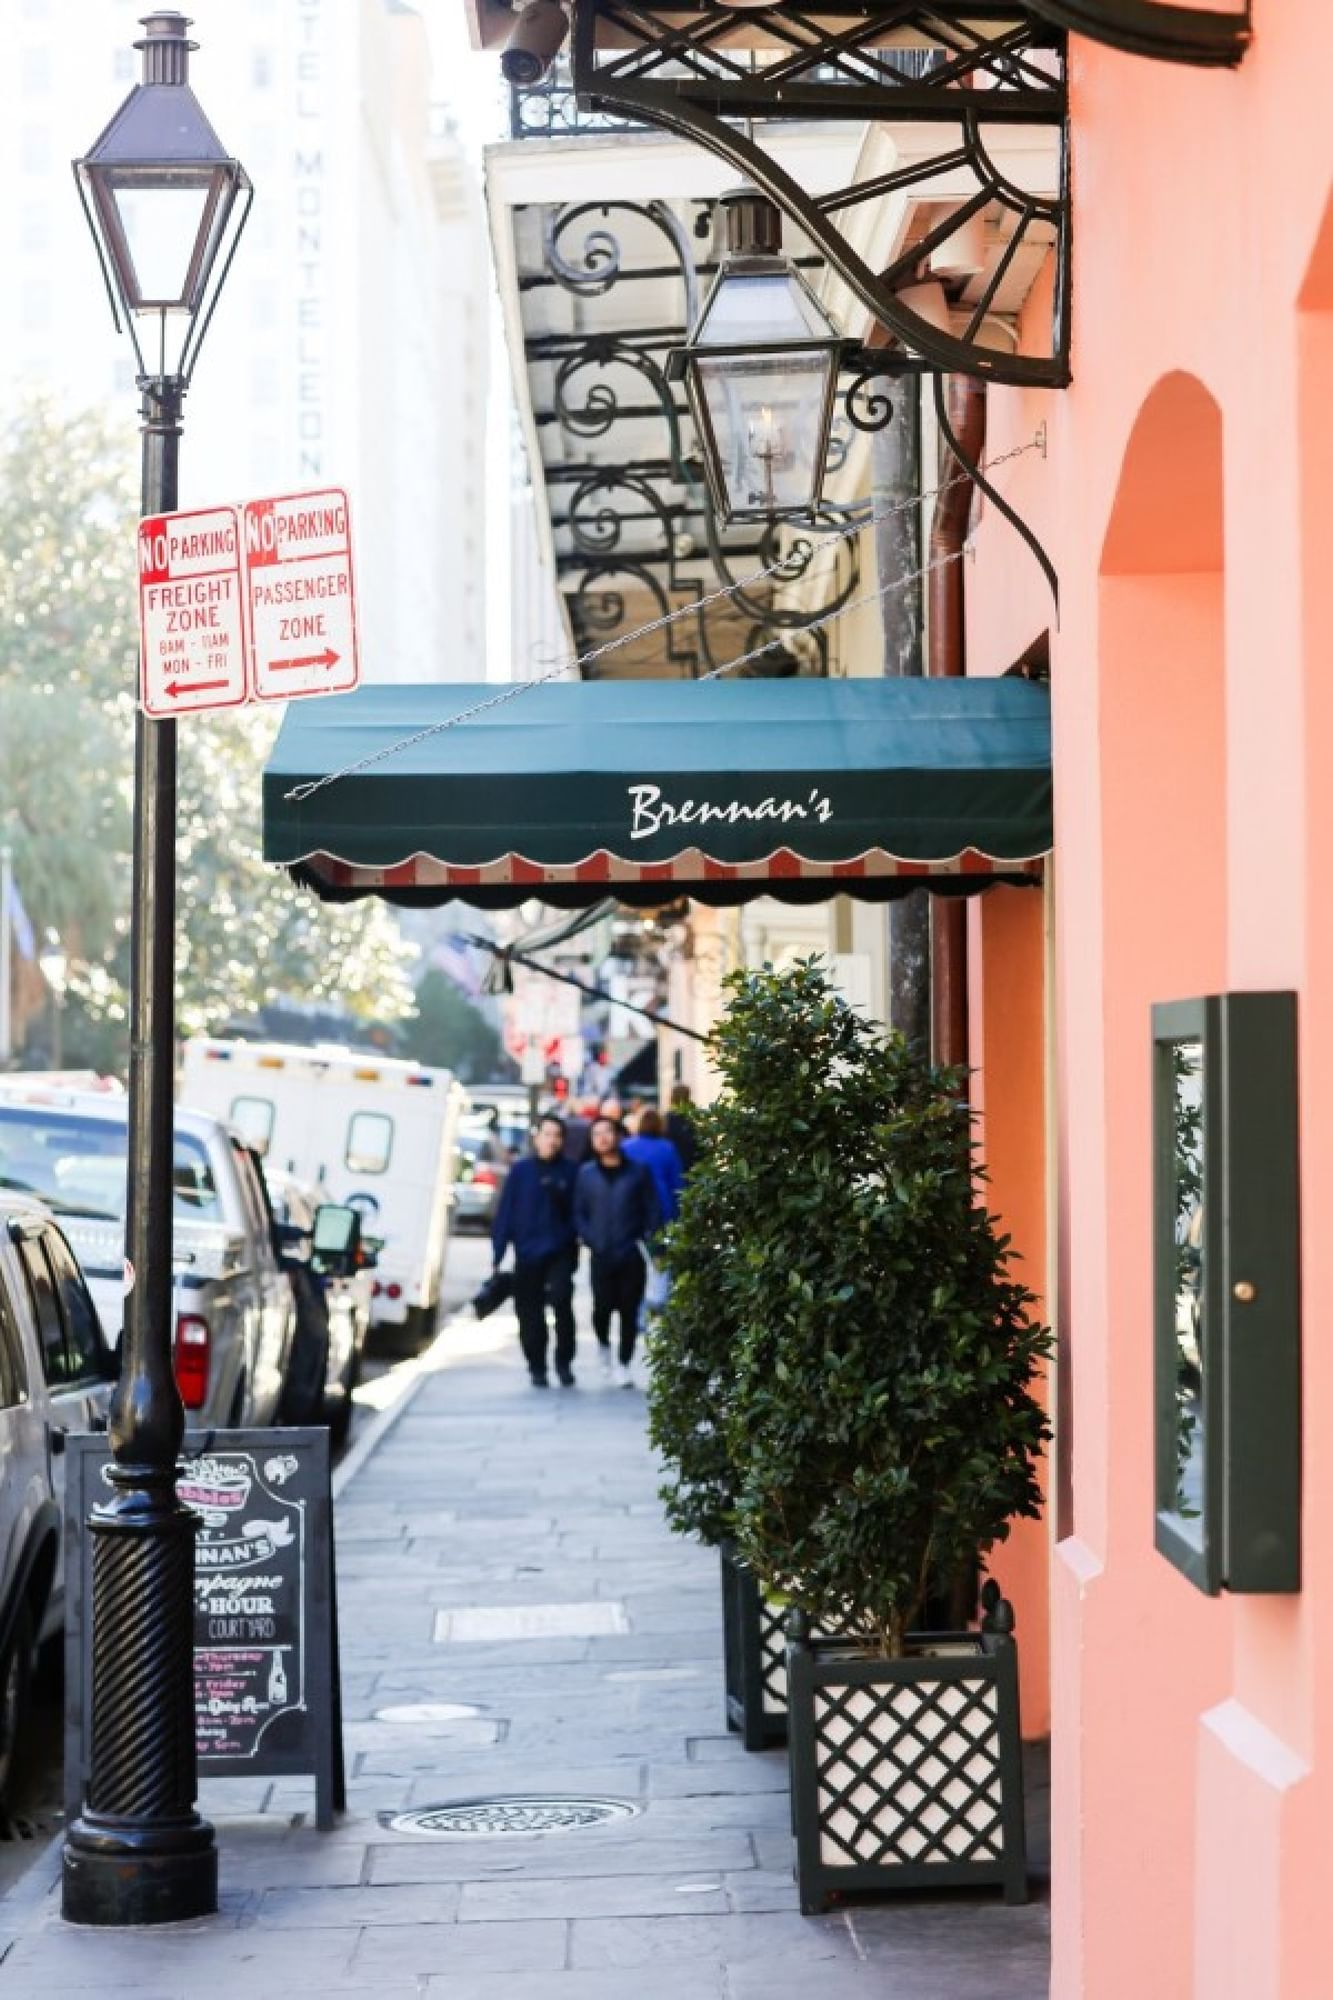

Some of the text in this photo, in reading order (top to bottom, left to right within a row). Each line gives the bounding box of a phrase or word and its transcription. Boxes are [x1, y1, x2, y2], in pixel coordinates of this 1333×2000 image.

[296, 0, 321, 118] TEL
[249, 507, 345, 552] NO PARKING
[141, 528, 234, 571] NO PARKING
[148, 578, 232, 611] FREIGHT
[254, 573, 347, 607] PASSENGER
[166, 606, 221, 633] ZONE
[279, 615, 327, 641] ZONE
[163, 659, 190, 675] MON
[207, 653, 228, 670] FRI
[628, 784, 833, 840] Brennan's
[208, 1597, 276, 1615] HOUR
